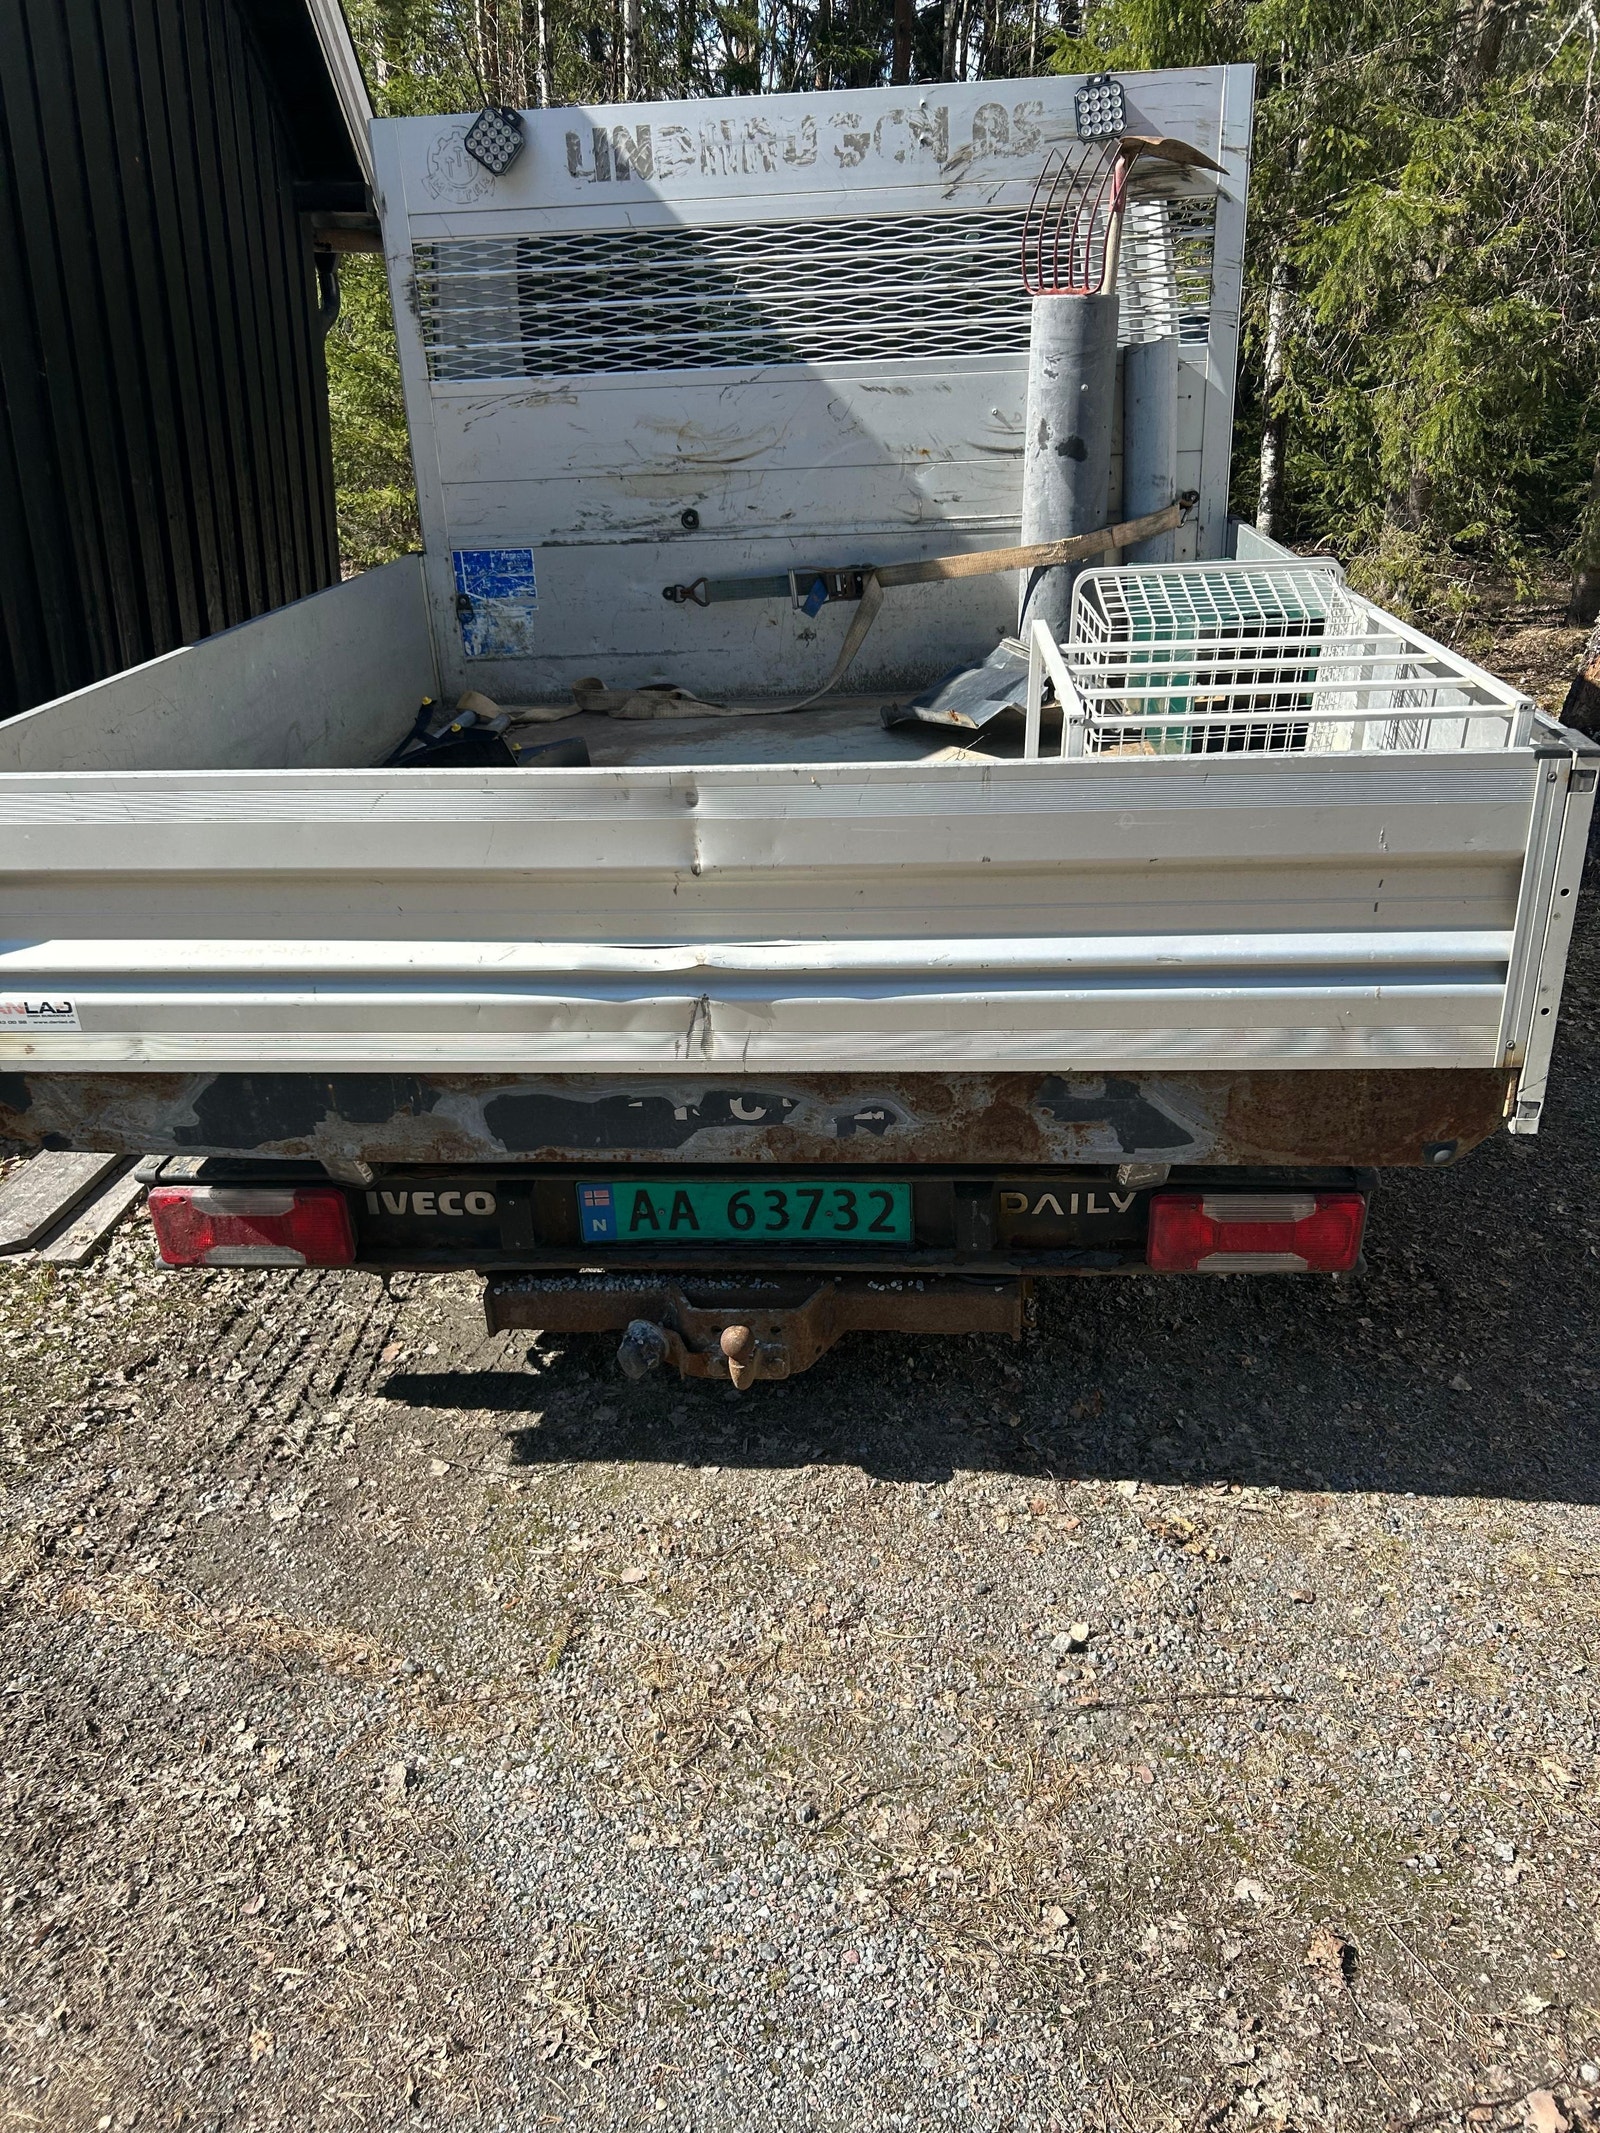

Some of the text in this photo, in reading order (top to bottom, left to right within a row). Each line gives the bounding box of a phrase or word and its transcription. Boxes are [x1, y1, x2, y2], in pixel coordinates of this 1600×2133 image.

[365, 1191, 497, 1216] IVECO
[629, 1189, 897, 1233] AA 63732
[1000, 1192, 1137, 1216] DAILY
[592, 1218, 608, 1232] N
